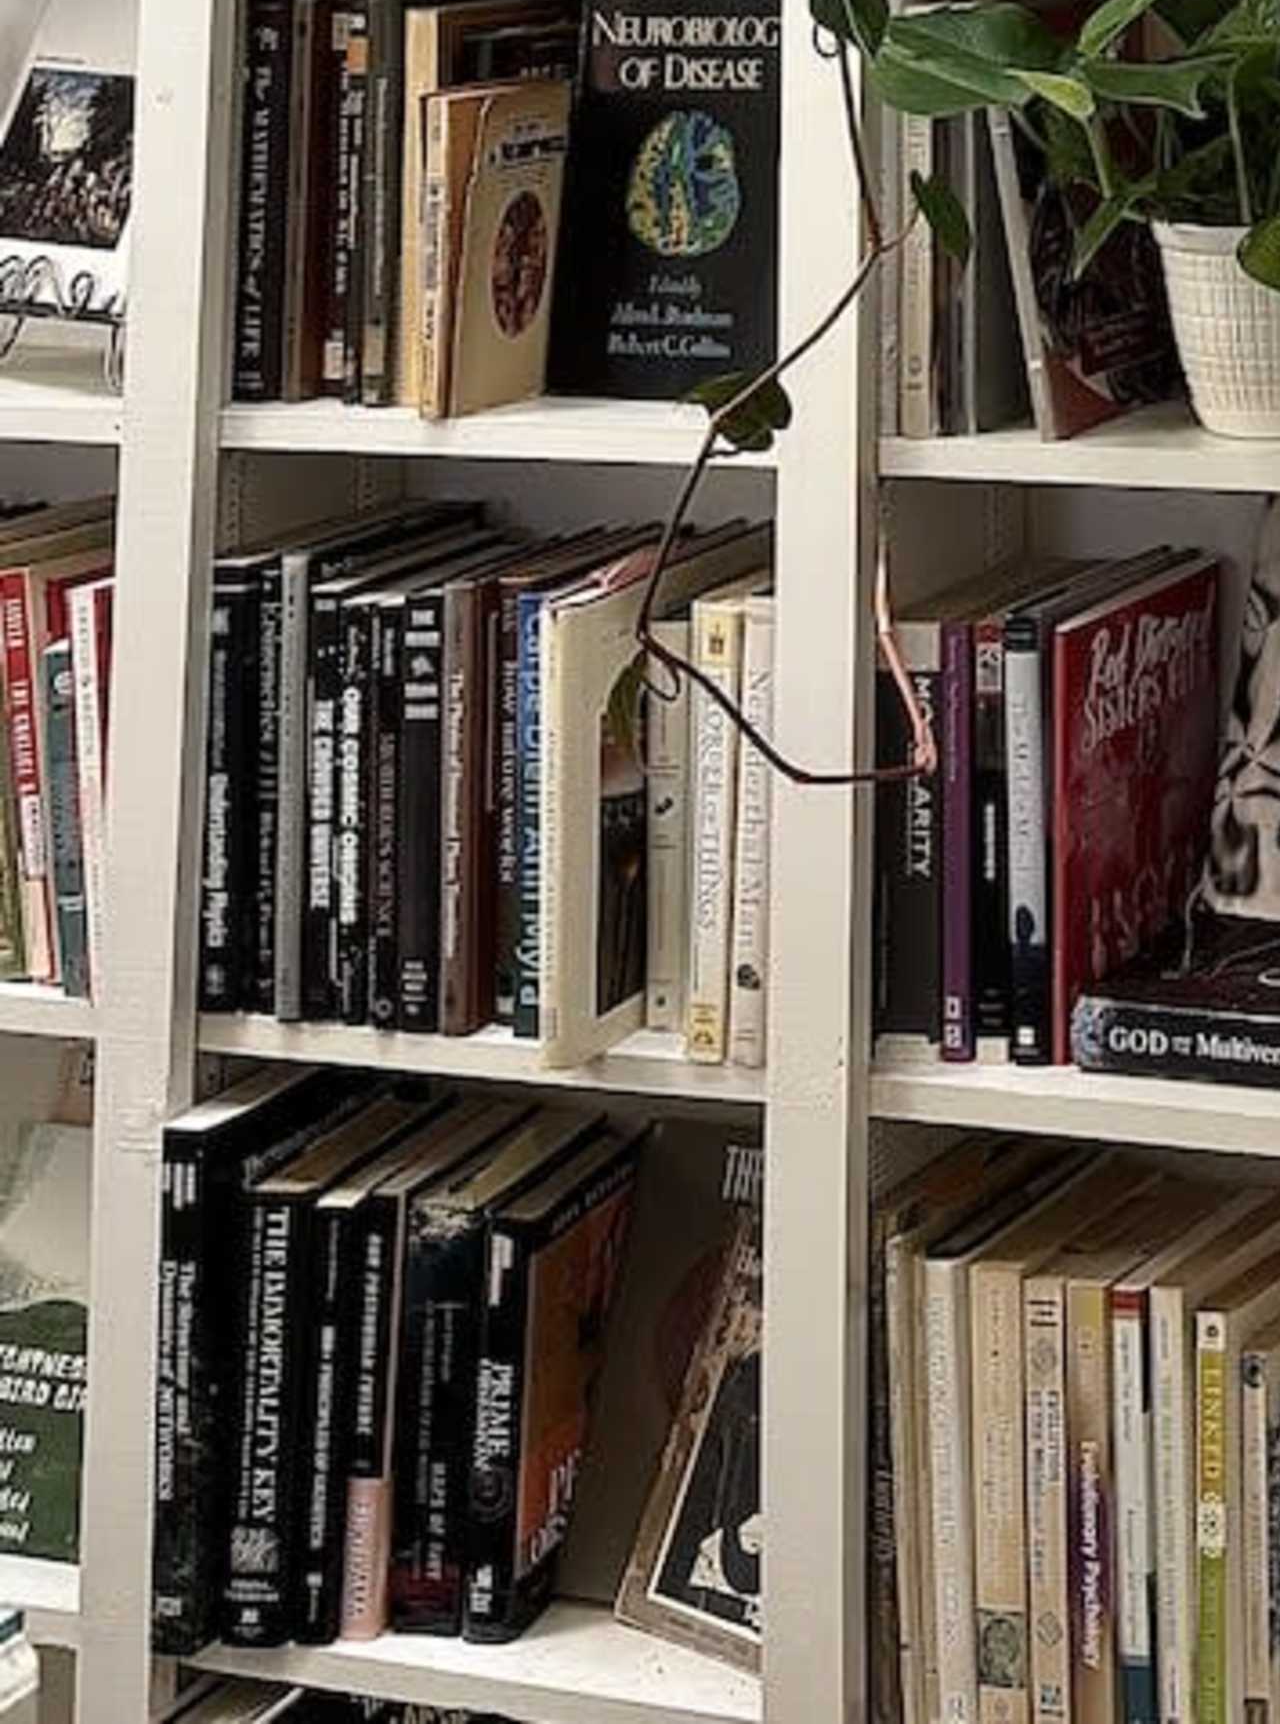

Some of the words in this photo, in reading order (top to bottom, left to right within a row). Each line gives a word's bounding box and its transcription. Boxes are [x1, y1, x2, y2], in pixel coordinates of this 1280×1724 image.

[592, 14, 781, 49] NEUROBIOLOG
[619, 61, 657, 89] OF
[662, 58, 764, 90] DISEASE
[246, 108, 271, 270] MATHEMATICS
[240, 304, 264, 359] LIFE
[340, 739, 361, 828] COSMIC
[501, 721, 519, 800] nature
[912, 676, 934, 877] MOLARITY
[205, 773, 229, 887] Understanding
[311, 824, 333, 910] UNIVERSE
[499, 808, 520, 883] works
[204, 890, 228, 948] Physics
[700, 827, 722, 932] THINGS
[737, 894, 763, 952] Man
[1109, 1025, 1169, 1054] GOD
[263, 1206, 291, 1266] THE
[177, 1260, 196, 1299] The
[257, 1271, 289, 1461] IMMORTALITY
[491, 1364, 514, 1456] PRIME
[1203, 1367, 1223, 1482] LINKED
[251, 1468, 276, 1524] KEY
[1079, 1441, 1099, 1557] Evolutionary
[1078, 1561, 1101, 1669] Psychology
